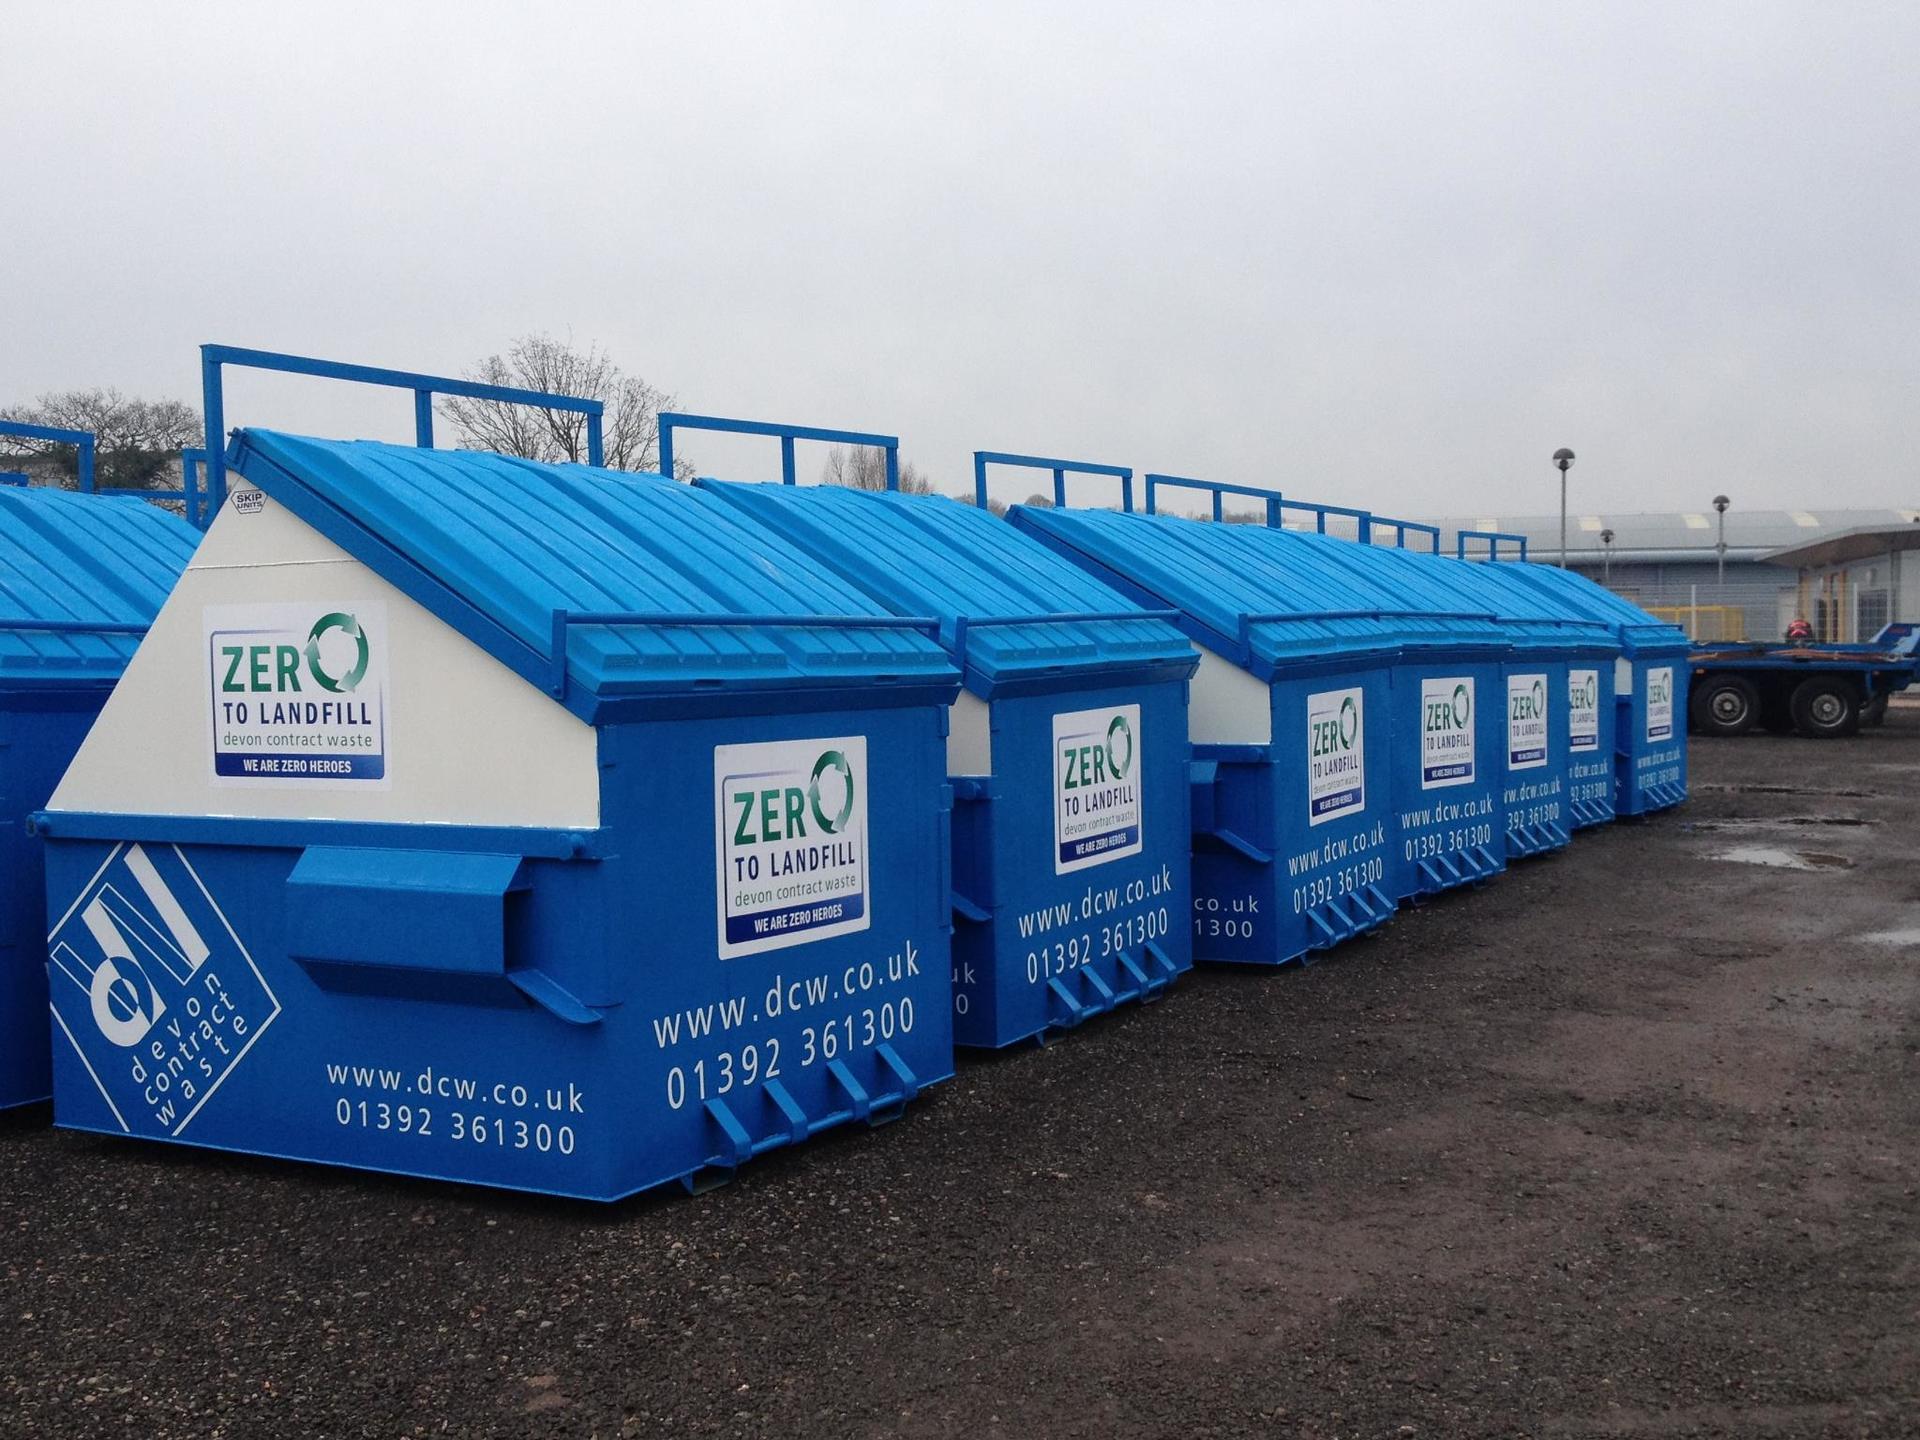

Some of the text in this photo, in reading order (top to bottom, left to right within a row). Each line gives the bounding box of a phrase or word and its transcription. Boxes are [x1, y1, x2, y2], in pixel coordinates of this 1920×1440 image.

[237, 493, 262, 502] SKIP
[223, 702, 372, 725] TO LANDFILL
[223, 731, 373, 748] devon contract waste
[1426, 733, 1470, 750] TO LANDFILL
[243, 759, 352, 774] WE ARE ZERO HEROES
[1313, 754, 1358, 779] TO LANDFILL
[1065, 785, 1133, 817] TO LANDFILL
[1401, 792, 1493, 829] www.dcw.co.uk
[1528, 801, 1559, 826] 361300
[1064, 822, 1087, 836] devon
[1089, 815, 1115, 831] contract
[1405, 824, 1491, 861] 01392 361300
[735, 841, 855, 882] TO LANDFILL
[1288, 820, 1384, 876] www.dcw.co.uk
[735, 875, 856, 907] devon contract waste
[1018, 864, 1172, 938] www.dcw.co.uk
[1293, 857, 1382, 914] 01392 361300
[754, 903, 843, 933] WE ARE ZERO HEROES
[1027, 907, 1168, 984] 01392 361300
[653, 940, 920, 1048] www.dcw.co.uk
[132, 972, 221, 1084] devon
[144, 991, 235, 1105] contract
[667, 997, 914, 1110] 01392 361300
[155, 1015, 248, 1127] waste
[327, 1063, 584, 1114] www.dcw.co.uk
[336, 1098, 575, 1155] 01392 361300
